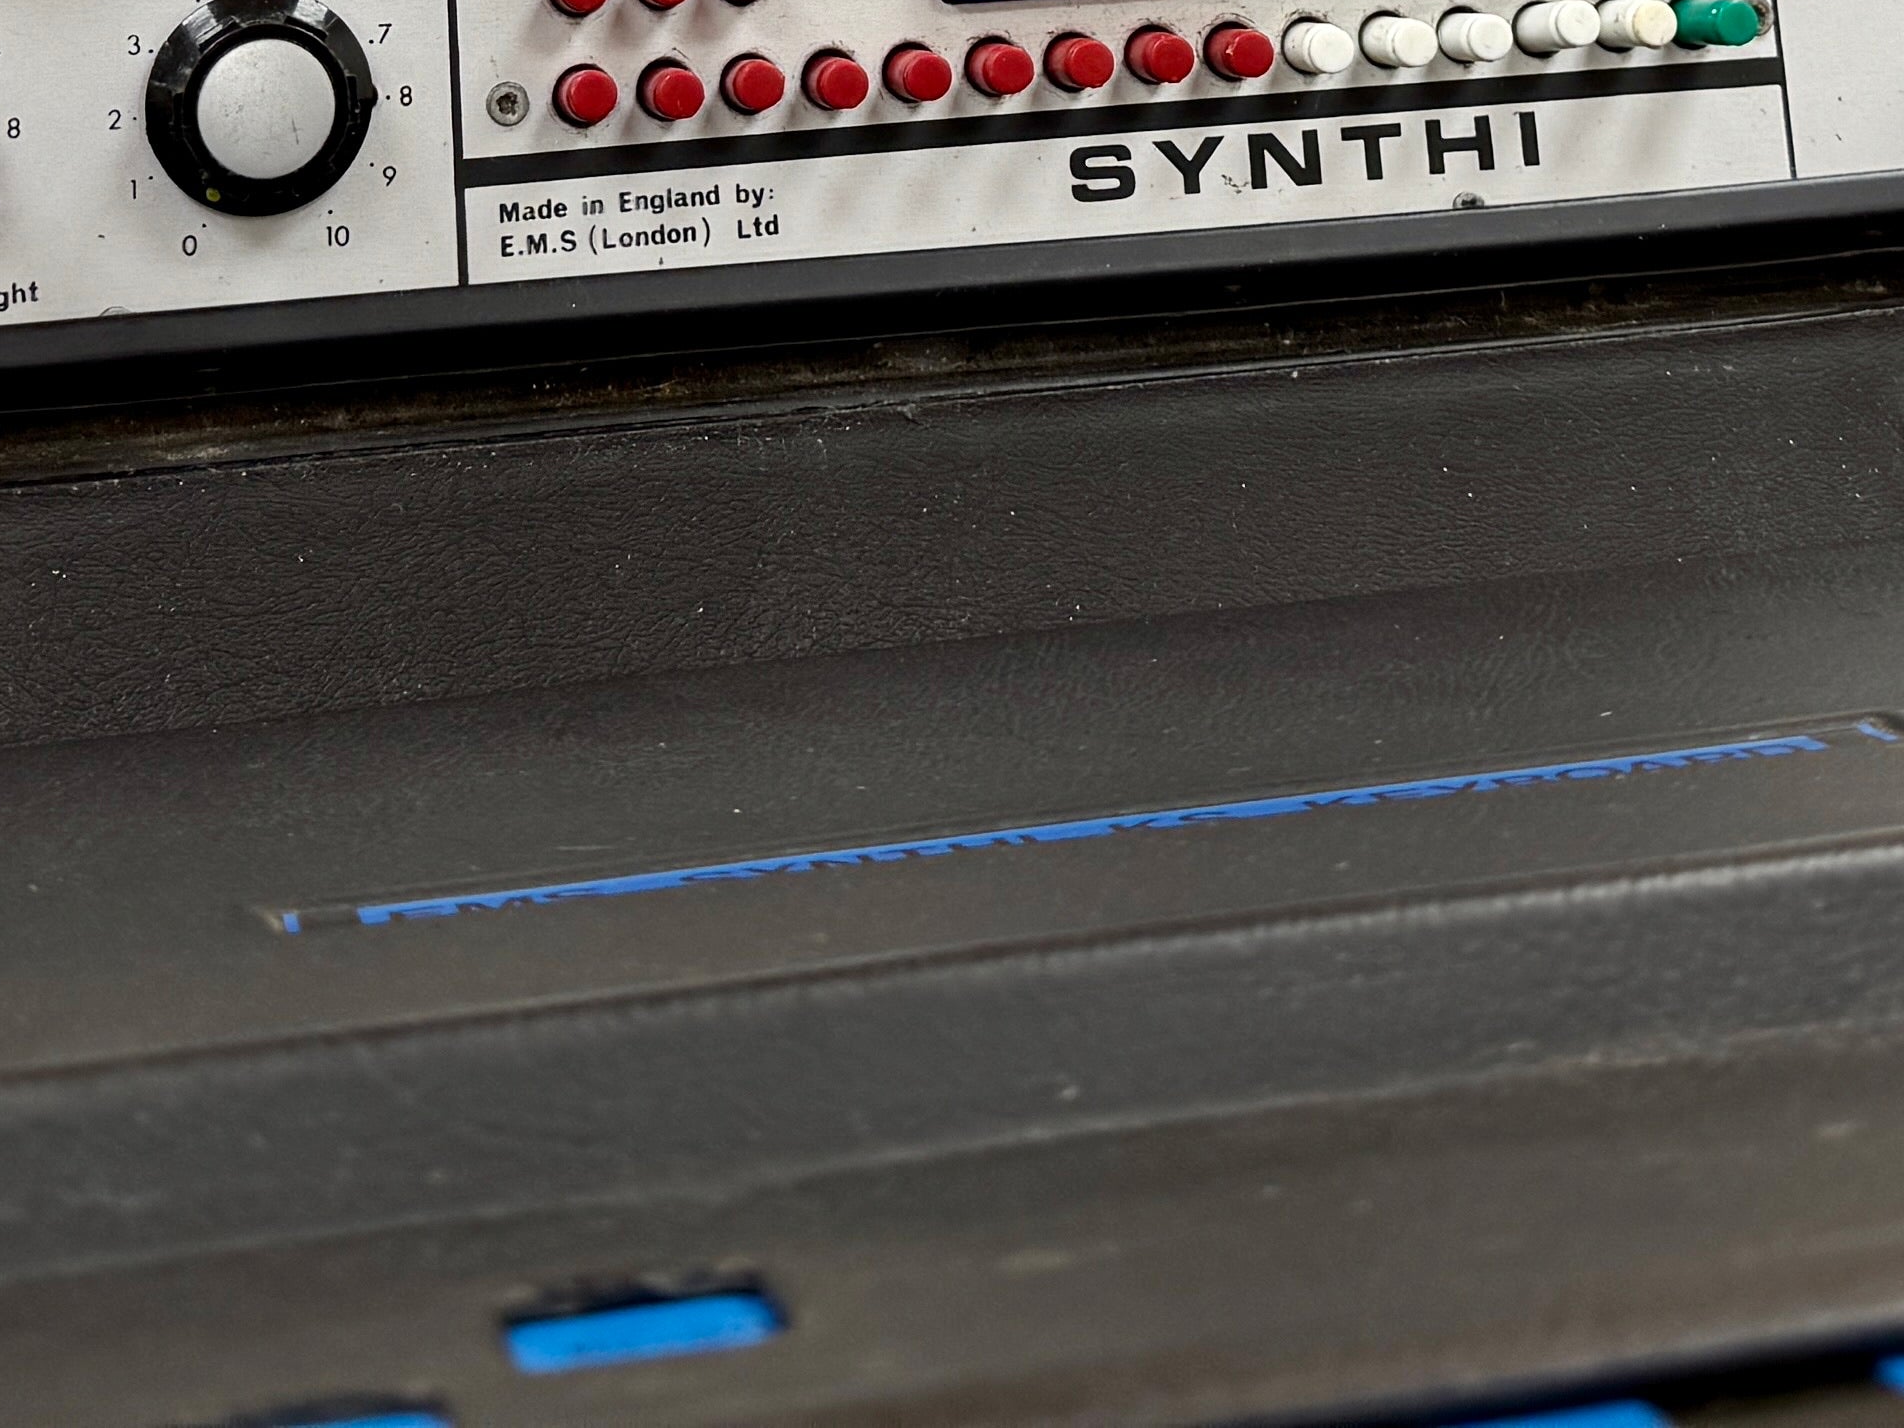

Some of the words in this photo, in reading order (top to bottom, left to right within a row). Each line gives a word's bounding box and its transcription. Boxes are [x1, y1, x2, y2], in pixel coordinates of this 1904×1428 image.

[1068, 109, 1542, 204] SYNTHI
[498, 197, 569, 225] Made
[581, 198, 605, 217] in
[617, 183, 722, 216] England
[733, 182, 777, 209] by:
[587, 215, 712, 257] (London)
[736, 212, 781, 241] Ltd
